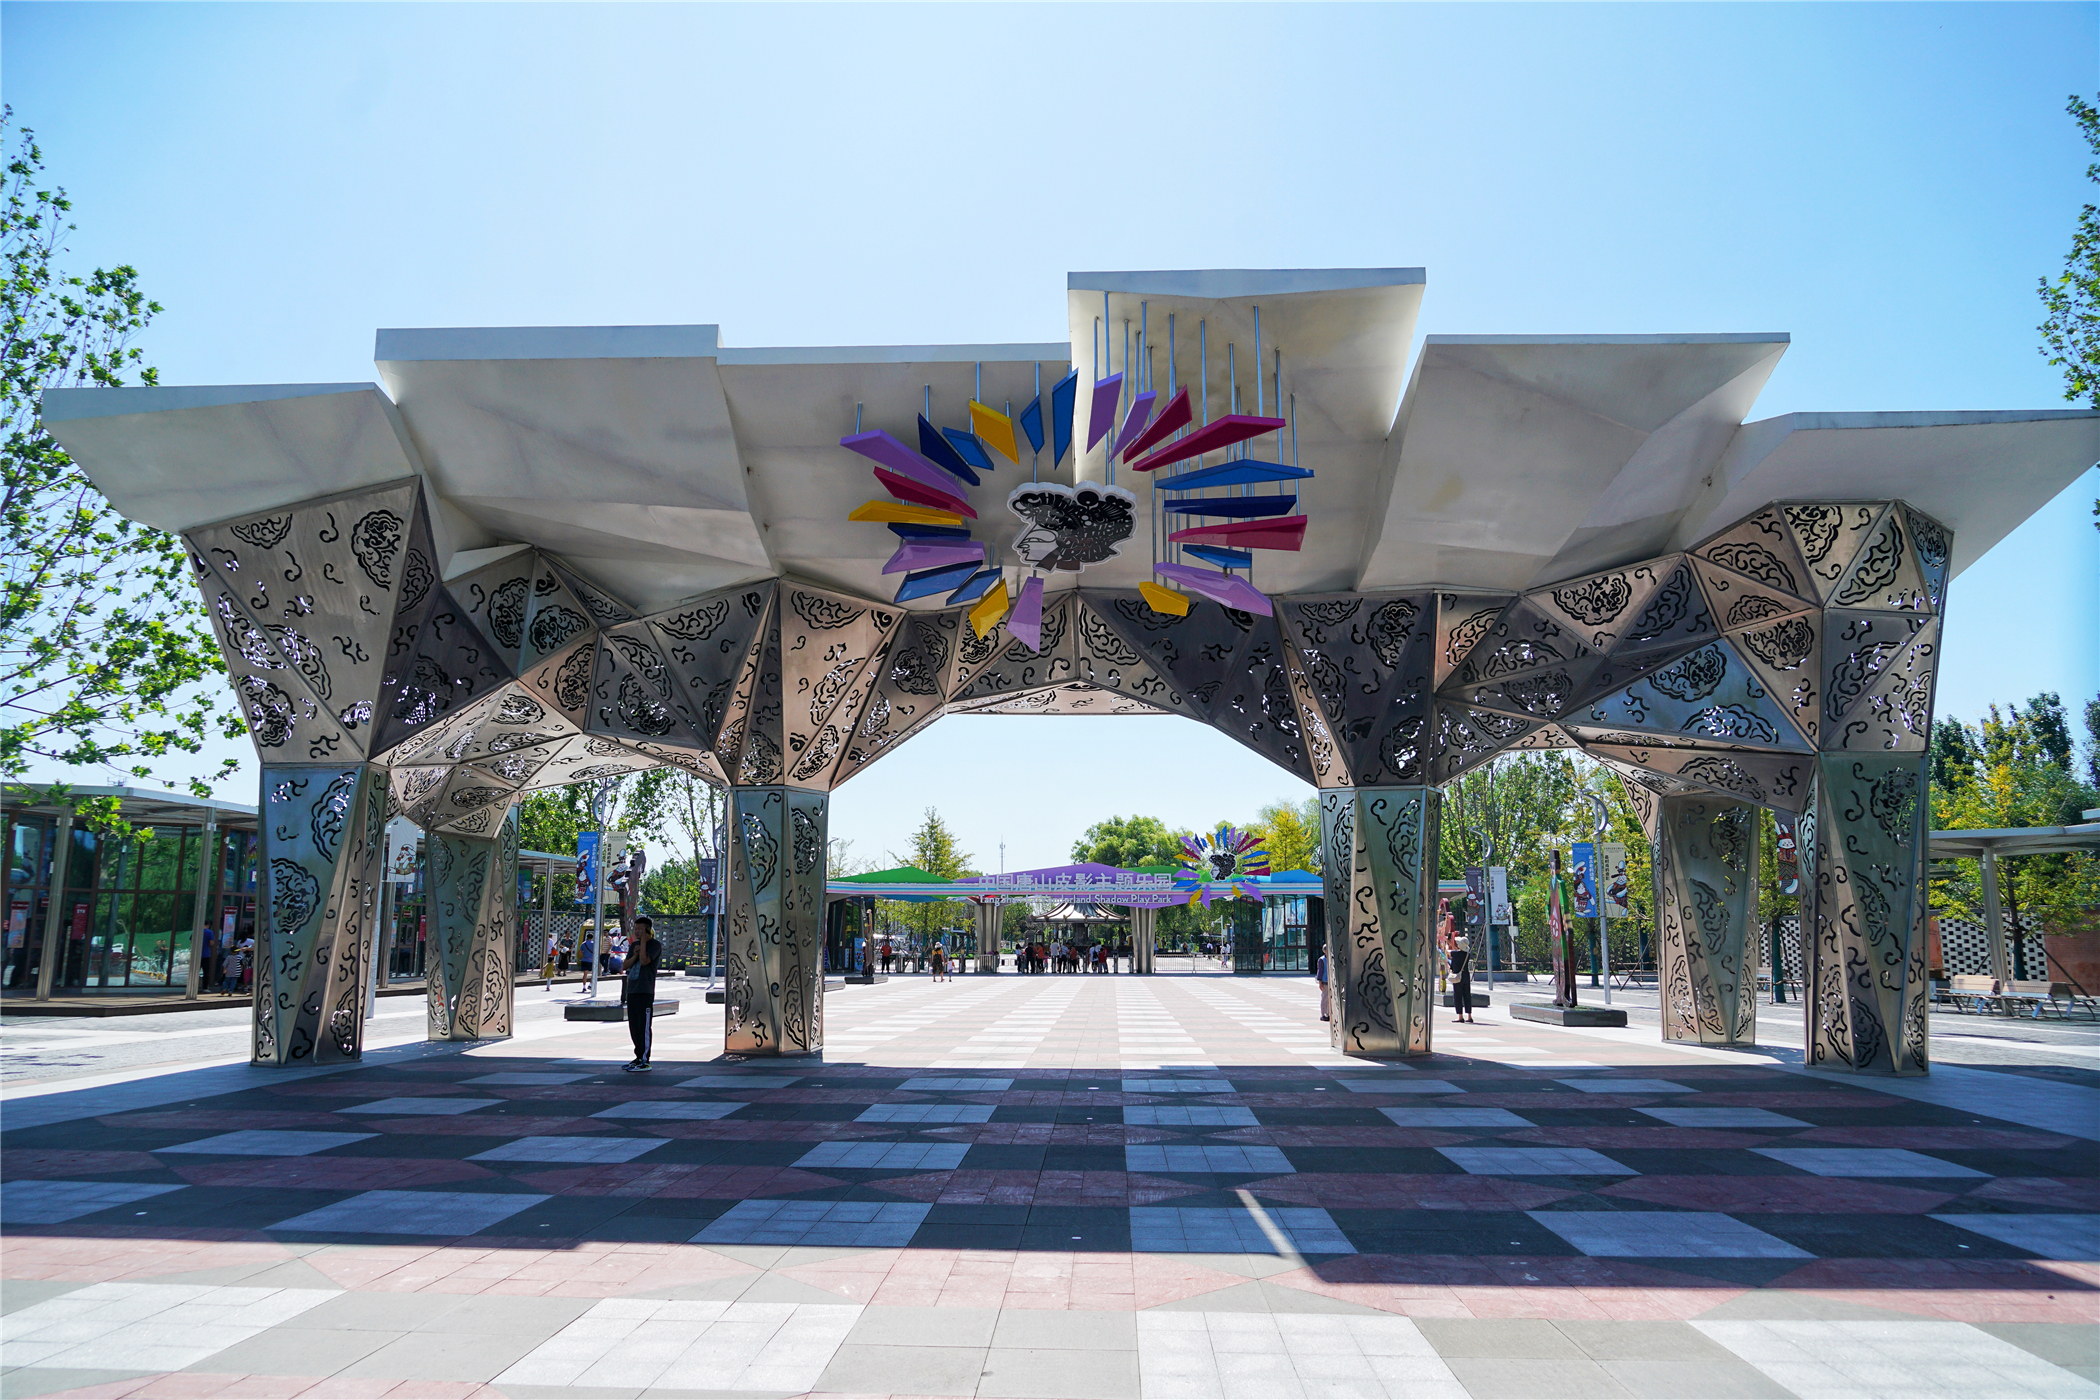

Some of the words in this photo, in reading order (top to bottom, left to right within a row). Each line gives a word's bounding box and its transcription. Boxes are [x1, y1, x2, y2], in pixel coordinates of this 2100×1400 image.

[979, 872, 1172, 892] 中国唐山皮影主题乐园
[1095, 894, 1129, 904] Shadow
[1131, 894, 1150, 906] Play
[1152, 894, 1172, 904] Park
